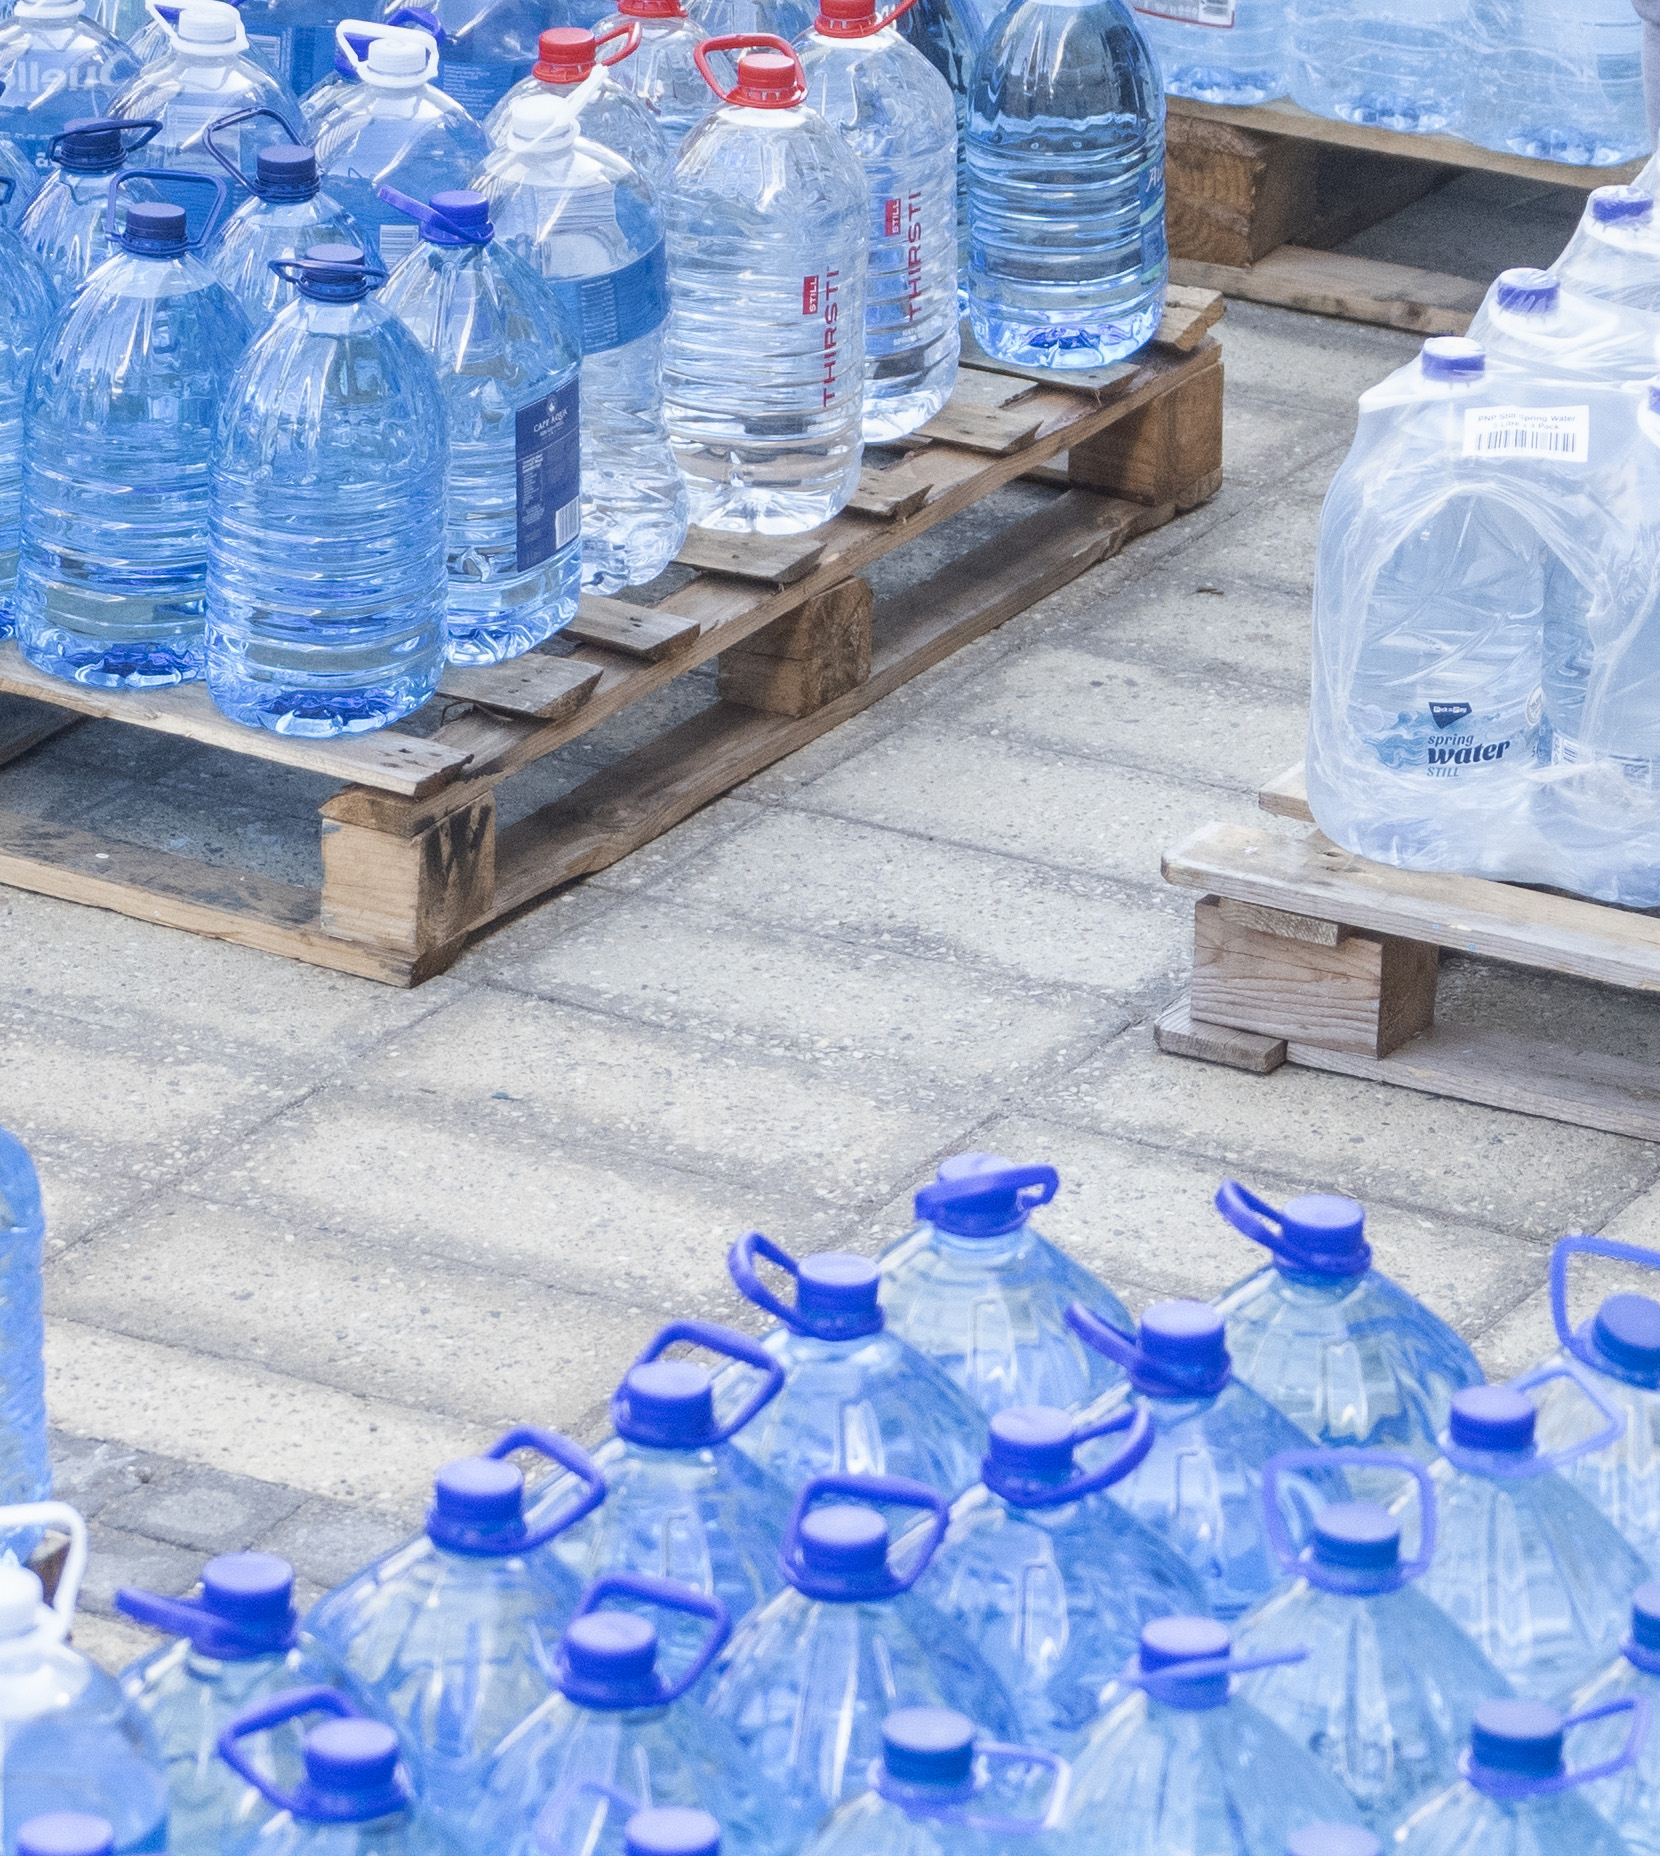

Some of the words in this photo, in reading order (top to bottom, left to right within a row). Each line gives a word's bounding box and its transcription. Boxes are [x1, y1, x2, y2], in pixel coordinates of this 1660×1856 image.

[891, 198, 900, 235] STILL
[907, 191, 922, 323] THIRSTI
[808, 277, 818, 313] STILL
[823, 270, 840, 408] THIRSTI
[1478, 414, 1497, 423] PNP
[1499, 412, 1516, 421] Still
[1550, 414, 1576, 423] Water
[1538, 422, 1560, 431] Pack
[1428, 733, 1475, 748] spring
[1428, 740, 1511, 766] water
[1427, 766, 1460, 778] STILL
